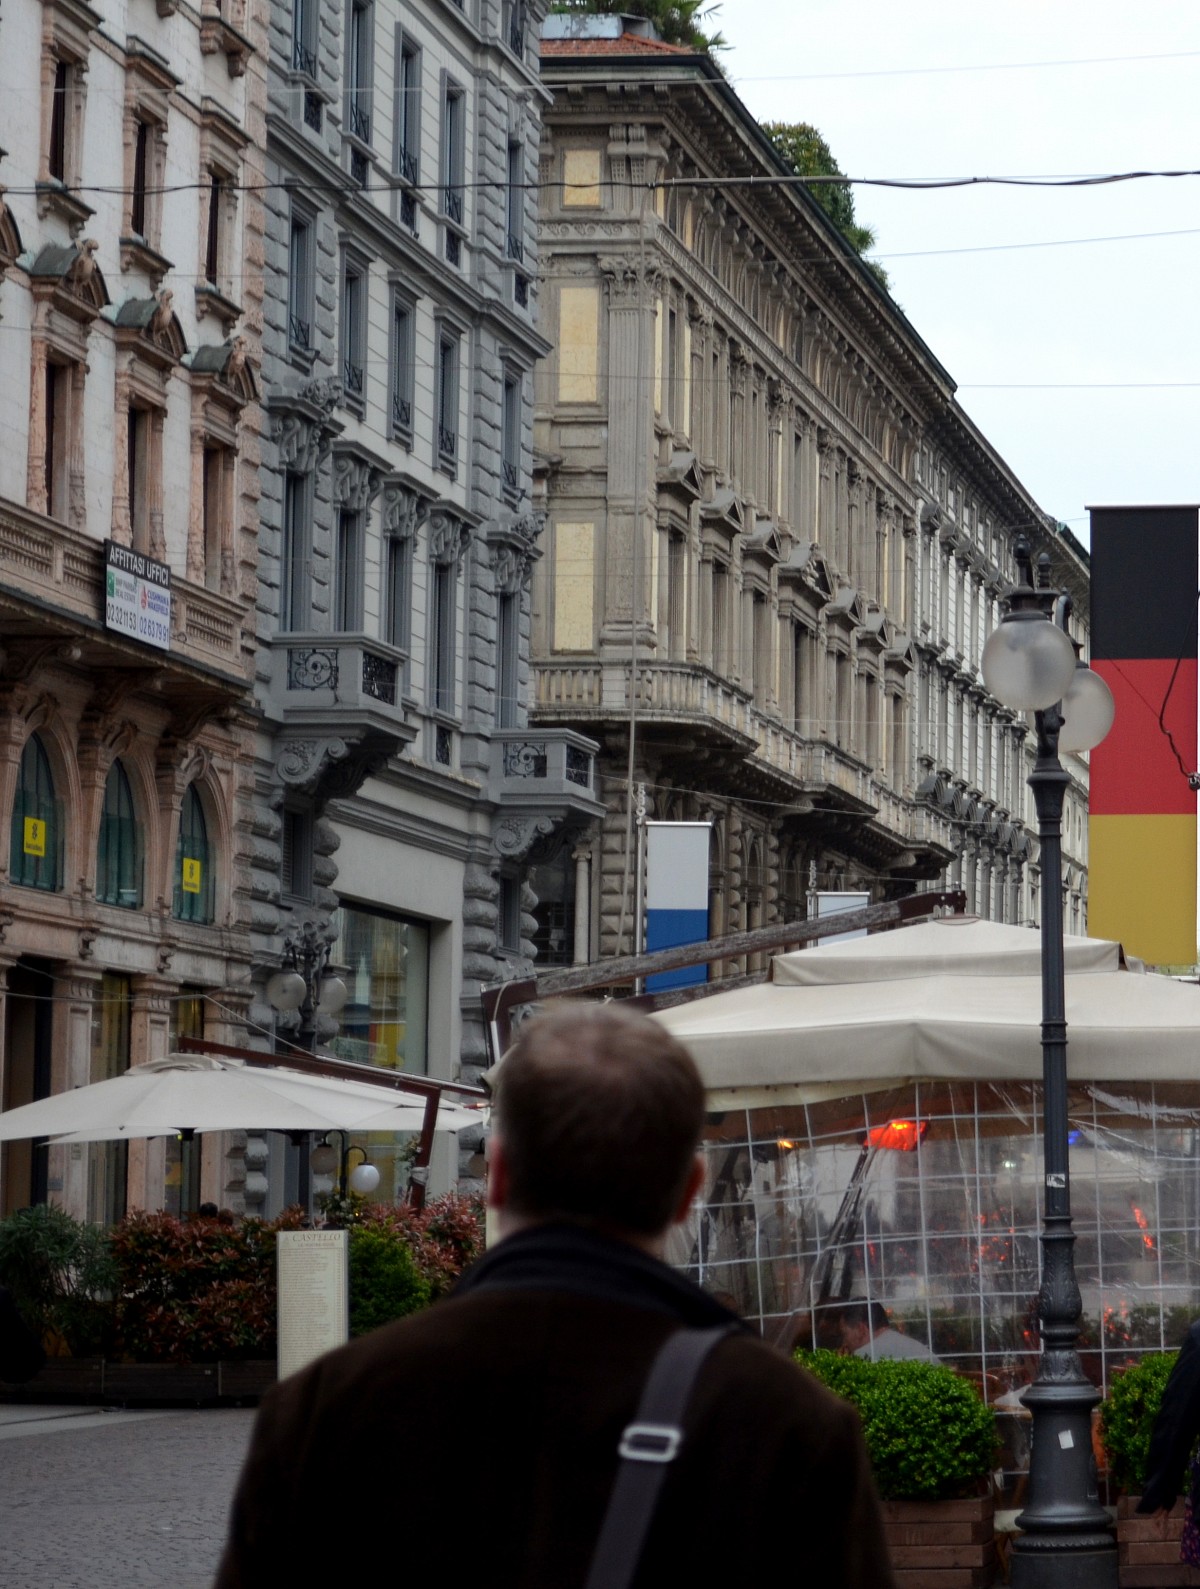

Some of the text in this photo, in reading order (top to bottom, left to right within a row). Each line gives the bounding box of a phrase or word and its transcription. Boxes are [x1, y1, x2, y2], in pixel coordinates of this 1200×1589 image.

[110, 546, 168, 586] AFFITTASI UFFICI
[292, 1232, 341, 1242] CASTELLO
